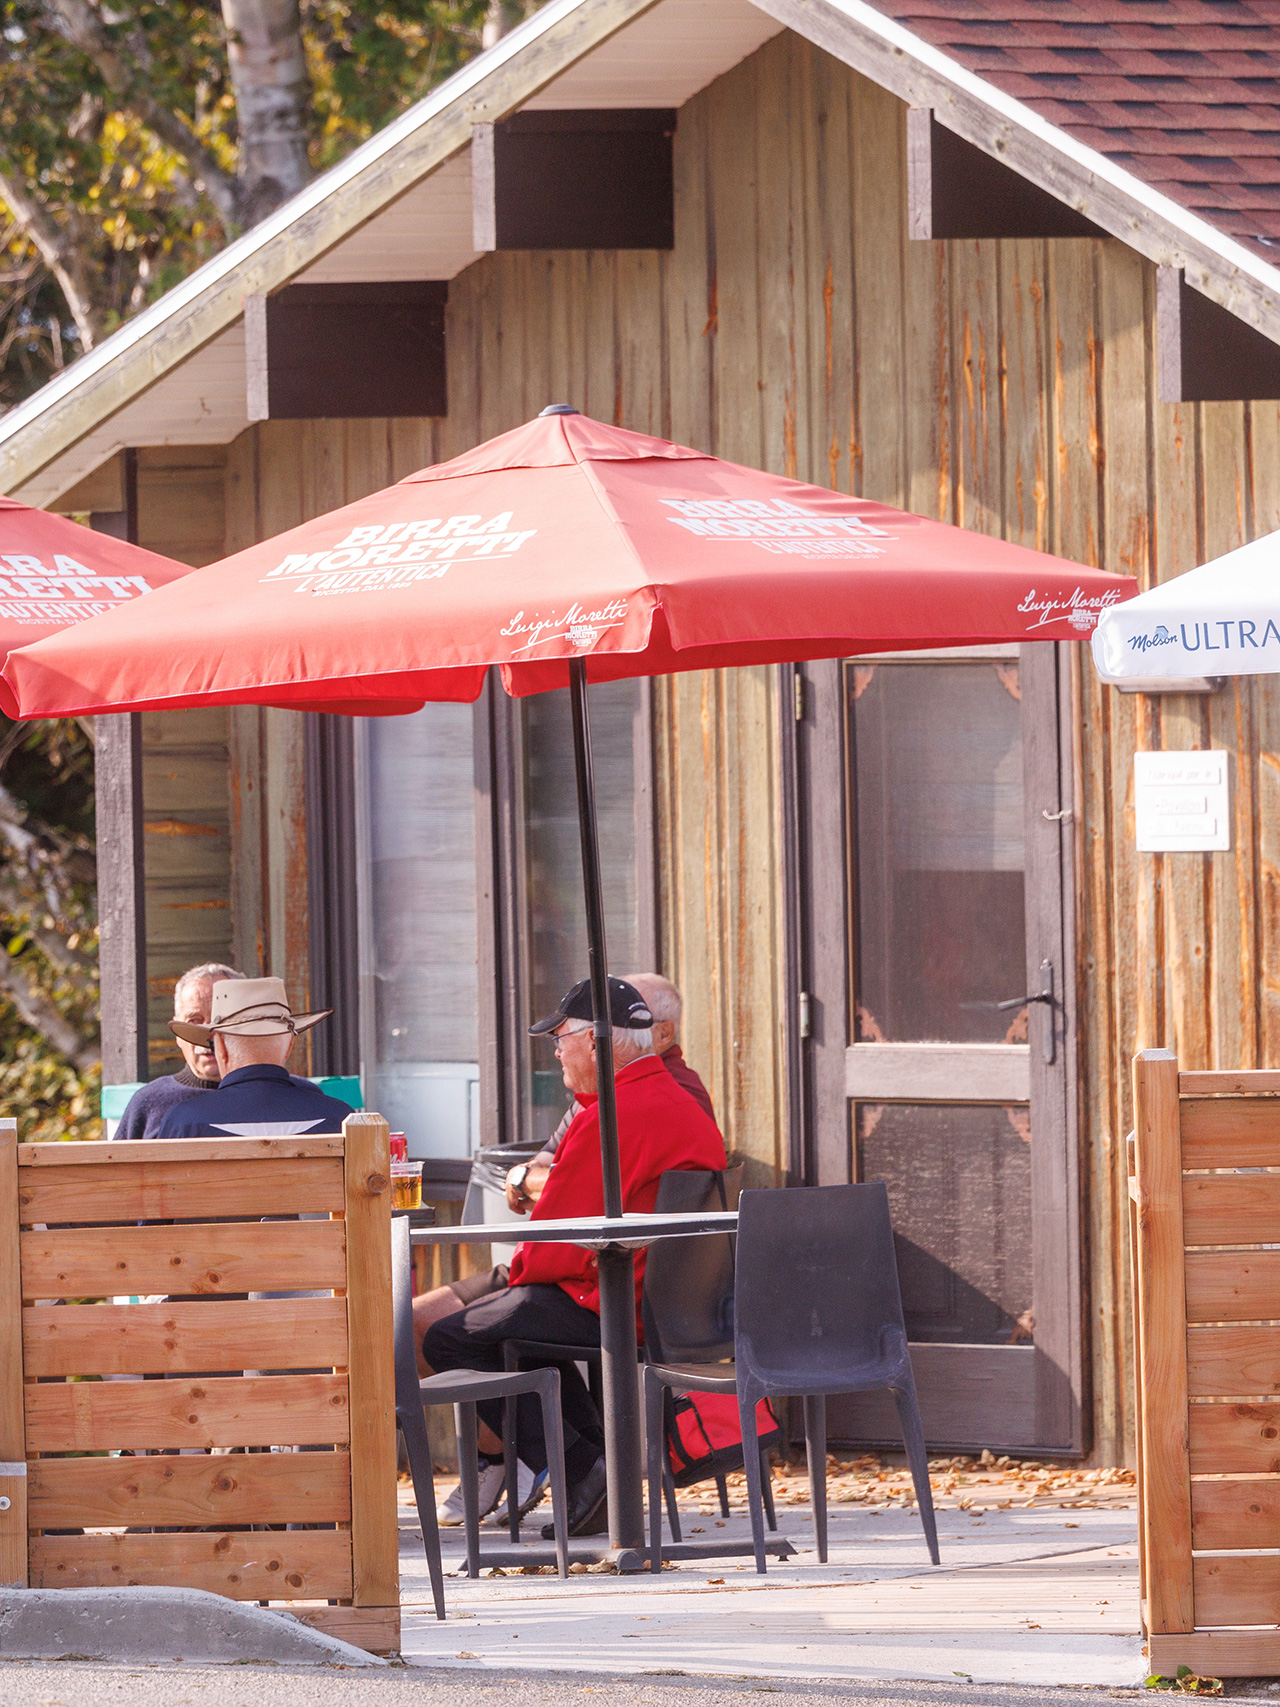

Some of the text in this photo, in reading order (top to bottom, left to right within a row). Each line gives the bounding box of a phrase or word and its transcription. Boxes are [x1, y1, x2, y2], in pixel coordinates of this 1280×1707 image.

[658, 498, 818, 518] BIRRA
[666, 516, 888, 536] MORETTI
[333, 511, 514, 549] BIRRA
[266, 529, 538, 576] MORETTI
[293, 563, 452, 592] L'AUTENTICA
[500, 598, 628, 646] Luigi Moretti
[1017, 586, 1121, 624] Luigi Moretti
[1127, 619, 1280, 653] Molson ULTRA
